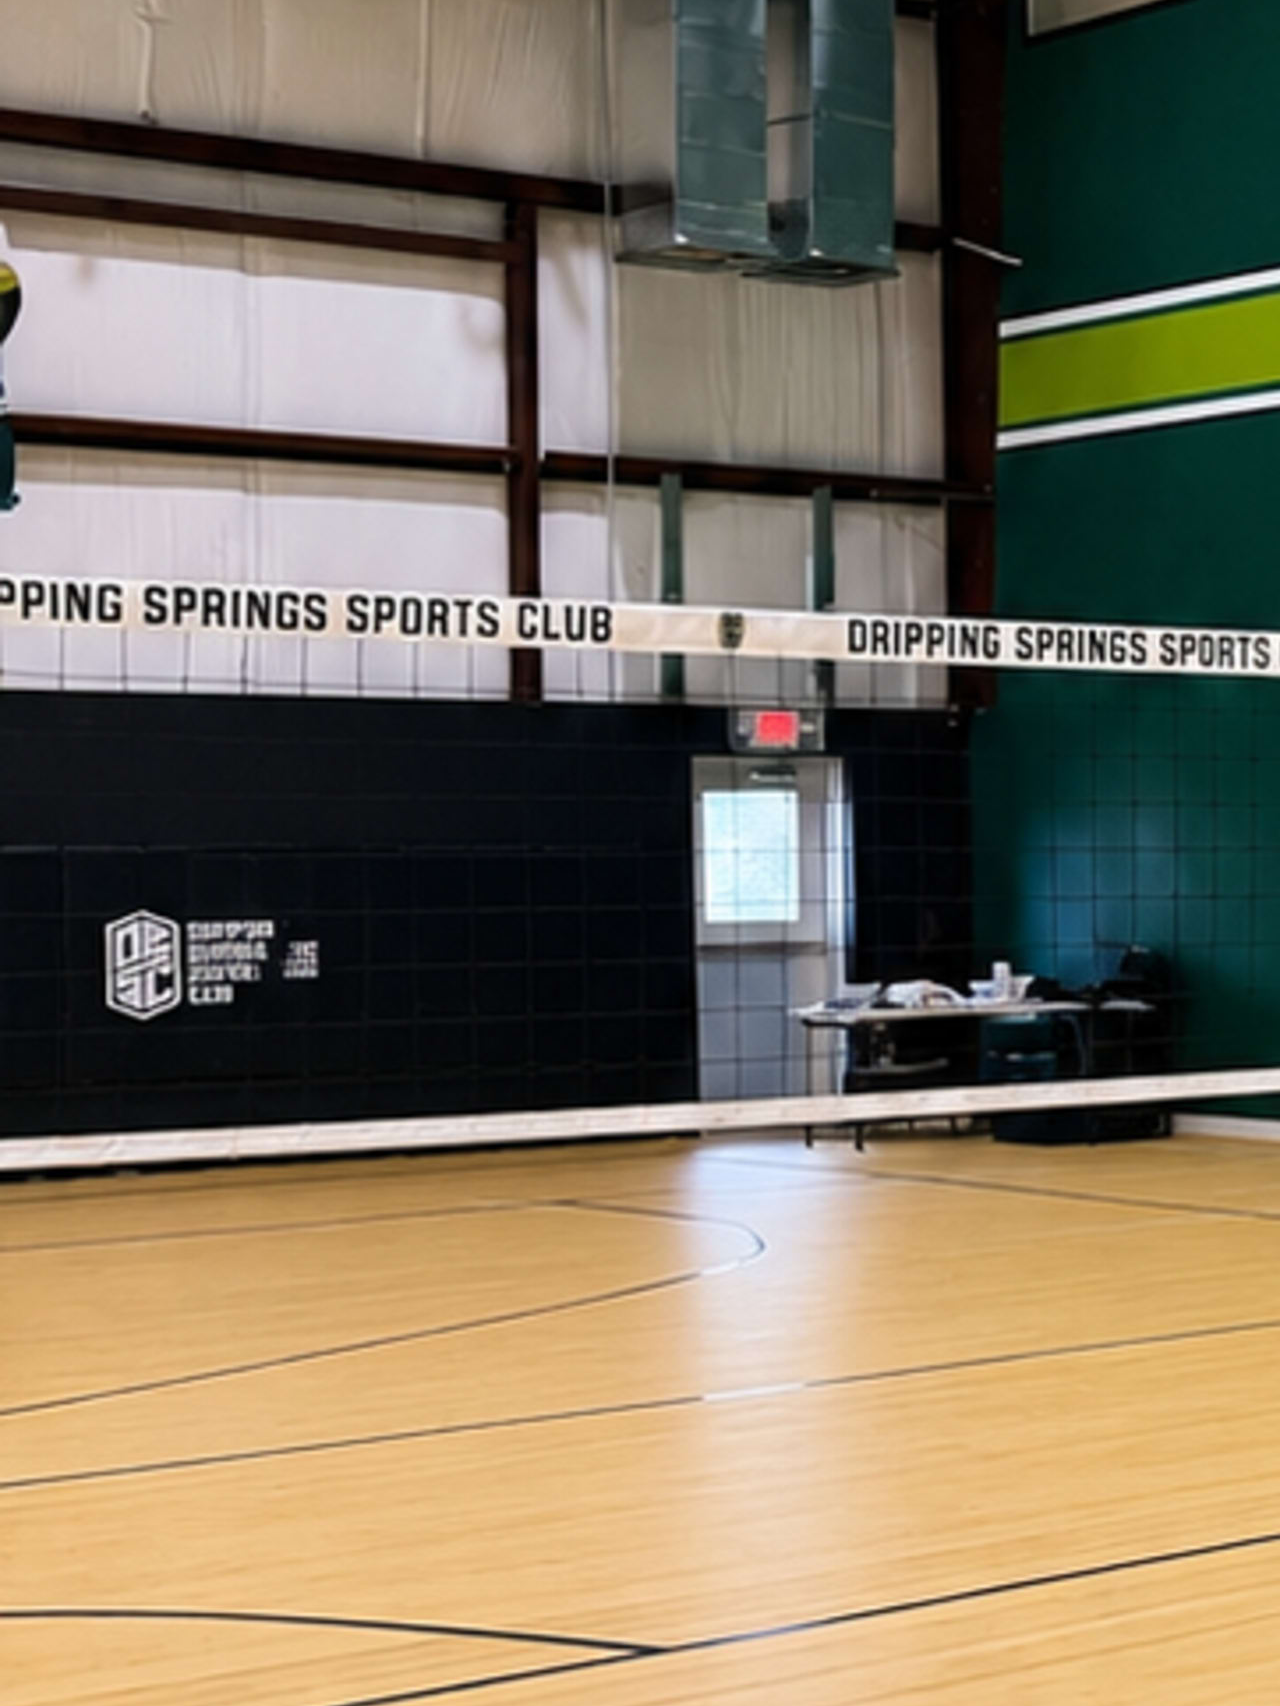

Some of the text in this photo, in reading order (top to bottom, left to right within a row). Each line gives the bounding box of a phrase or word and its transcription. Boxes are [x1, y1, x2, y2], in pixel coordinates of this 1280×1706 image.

[143, 586, 327, 632] SPRINGS
[346, 594, 499, 638] SPORTS
[517, 602, 613, 642] CLUB
[847, 619, 1001, 659] DRIPPING
[1014, 626, 1148, 664] SPRINGS
[1159, 633, 1271, 670] SPORTS
